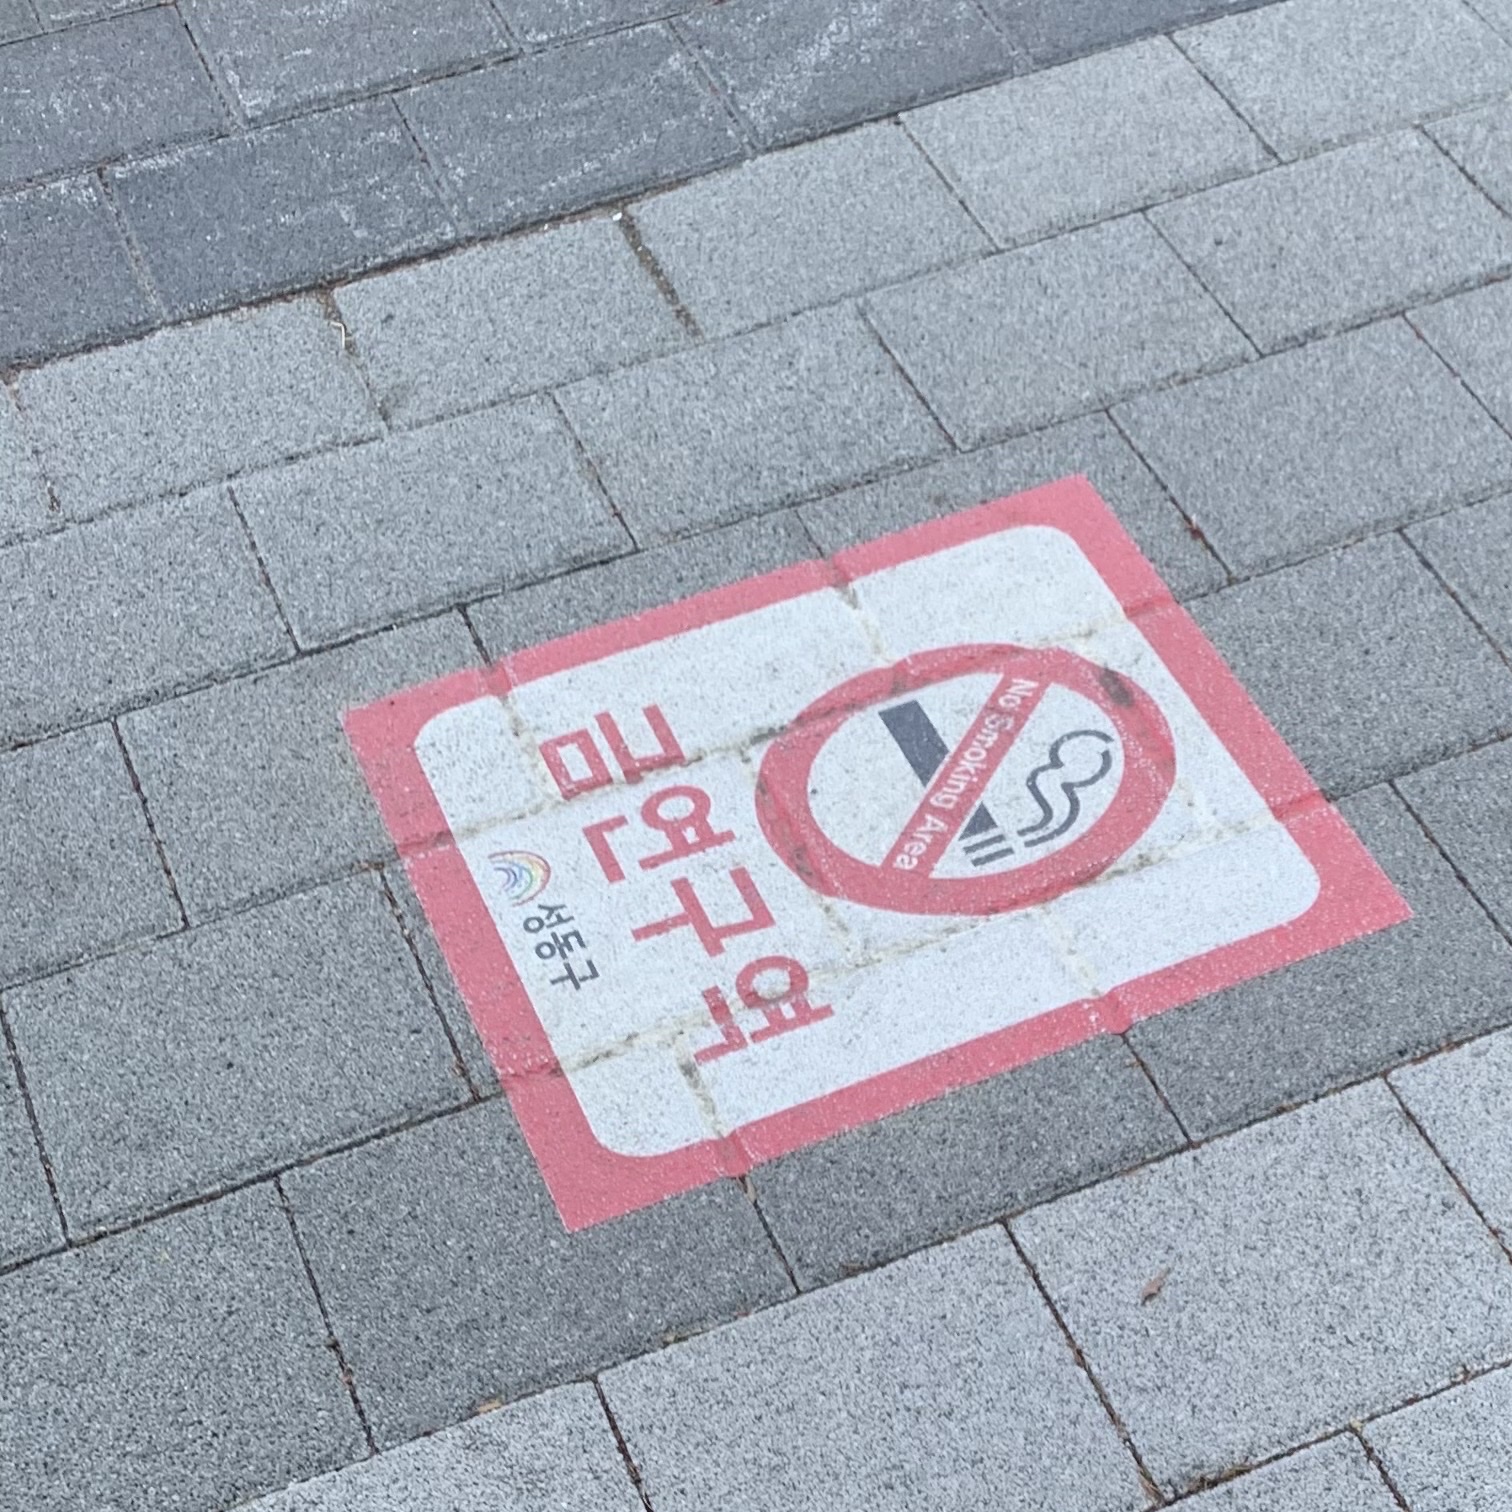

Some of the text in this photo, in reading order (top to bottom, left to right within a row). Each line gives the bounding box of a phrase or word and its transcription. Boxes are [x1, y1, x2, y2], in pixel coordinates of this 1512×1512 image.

[892, 677, 1039, 870] No Smoking Area
[522, 903, 600, 991] 성동구
[538, 703, 835, 1066] 금연구역
